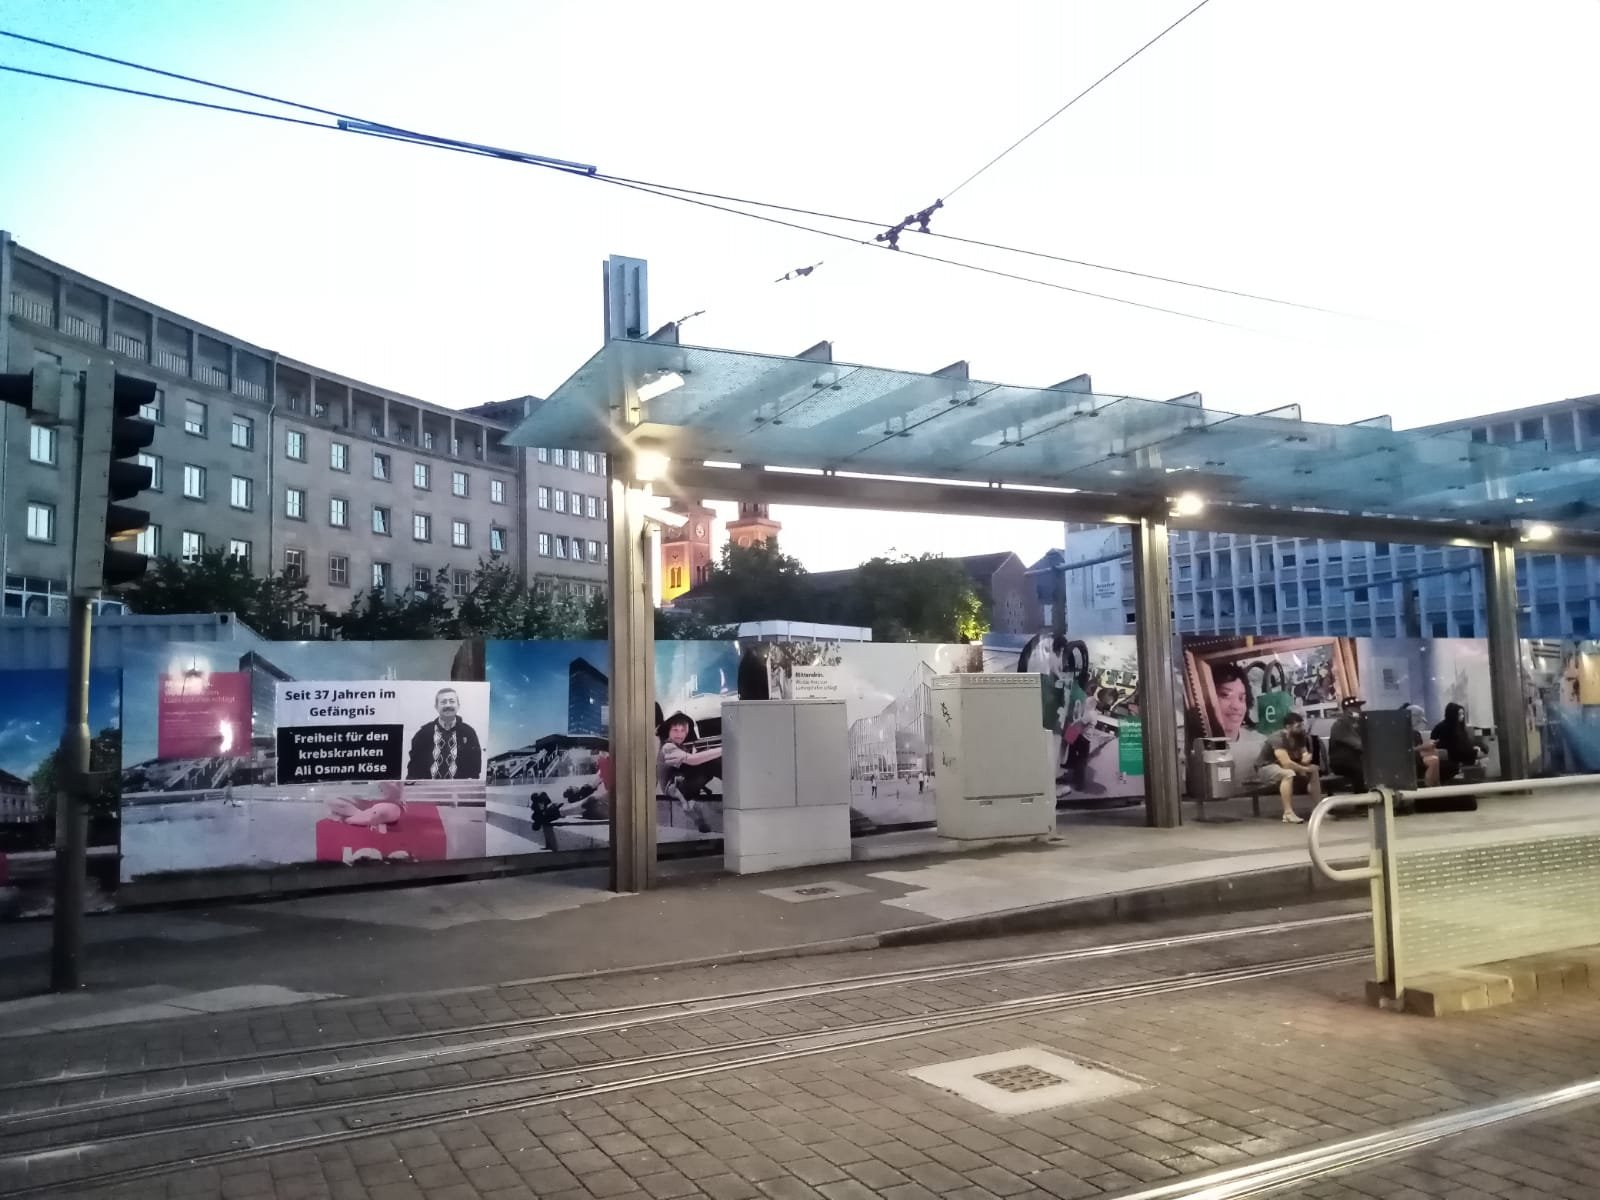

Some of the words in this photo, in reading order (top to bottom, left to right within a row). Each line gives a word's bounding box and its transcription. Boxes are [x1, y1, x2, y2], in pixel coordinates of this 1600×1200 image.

[285, 690, 311, 701] Seit
[314, 690, 330, 700] 37
[331, 689, 376, 702] Jahren
[379, 688, 396, 699] im
[309, 705, 376, 719] Gefängnis
[294, 732, 343, 744] Freiheit
[345, 731, 364, 742] für
[366, 731, 389, 741] den
[298, 747, 384, 760] krebskranken
[294, 764, 312, 776] Ali
[314, 764, 355, 775] Osman
[358, 762, 388, 773] Köse
